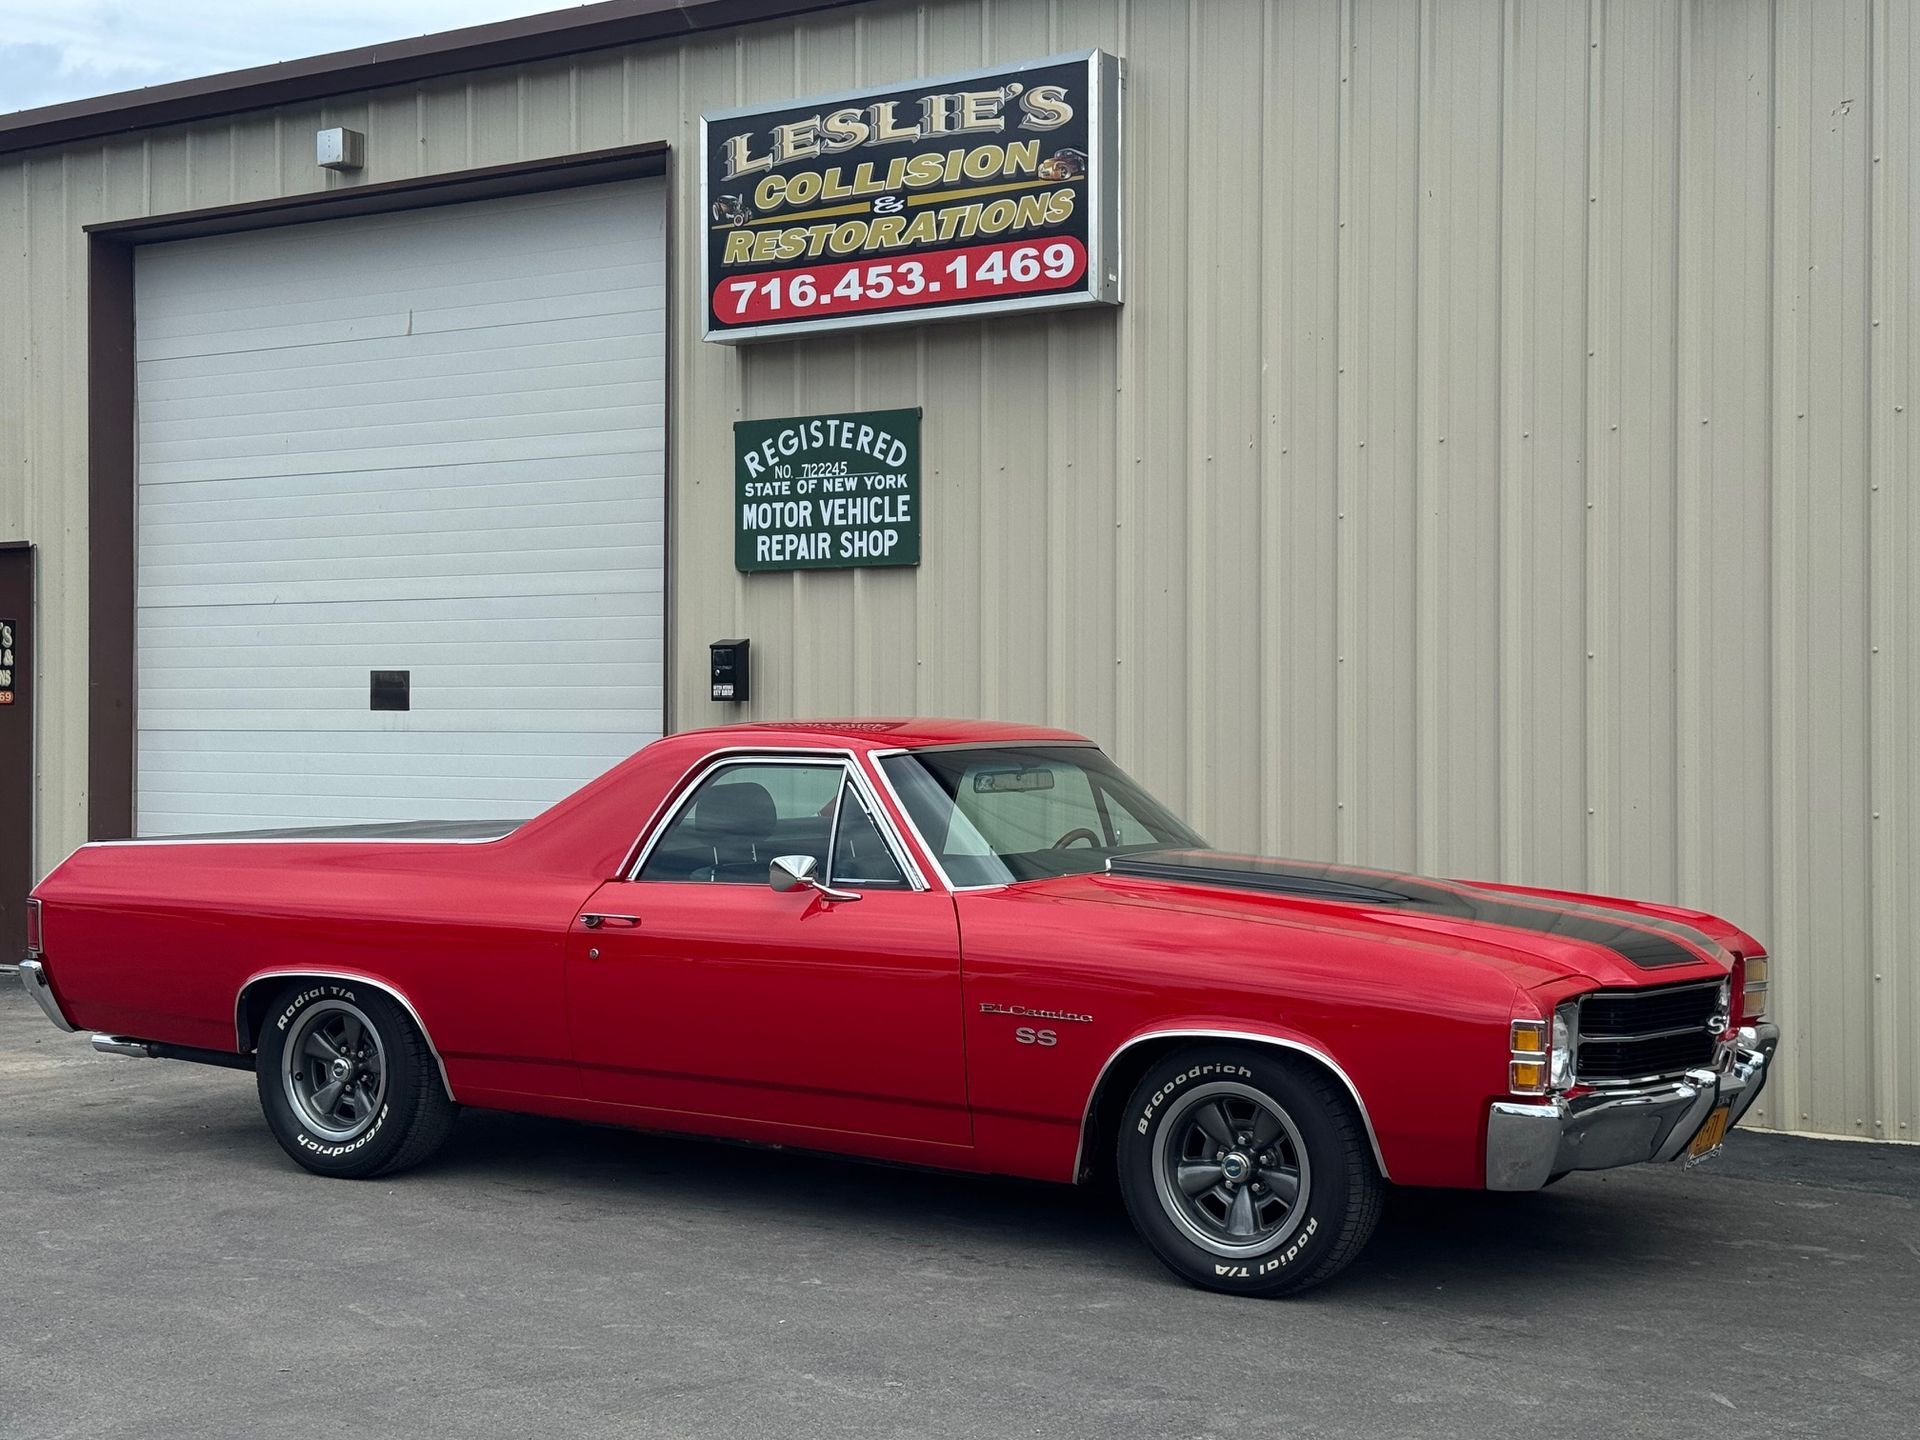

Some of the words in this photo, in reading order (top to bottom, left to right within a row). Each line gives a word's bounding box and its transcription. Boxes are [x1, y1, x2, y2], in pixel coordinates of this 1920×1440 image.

[721, 82, 1075, 182] LESLIE'S
[754, 139, 1041, 211] COLLISION
[723, 188, 1077, 265] RESTORATIONS
[873, 196, 905, 214] &
[729, 243, 1076, 314] 716.453.1469
[743, 419, 908, 479] REGISTERED
[774, 464, 794, 479] NO.
[801, 461, 848, 478] 7122245
[745, 481, 791, 497] STATE
[797, 479, 817, 494] OF
[823, 476, 858, 492] NEW
[864, 473, 908, 490] YORK
[743, 500, 812, 530] MOTOR
[819, 494, 911, 526] VEHICLE
[757, 532, 831, 562] REPAIR
[840, 529, 898, 559] SHOP
[277, 986, 325, 1031] Radial
[330, 986, 356, 1002] T/A
[1015, 1027, 1057, 1046] SS
[1137, 1063, 1252, 1135] BFGoodrich
[1259, 1217, 1318, 1275] Radial
[1215, 1263, 1250, 1278] T/A
